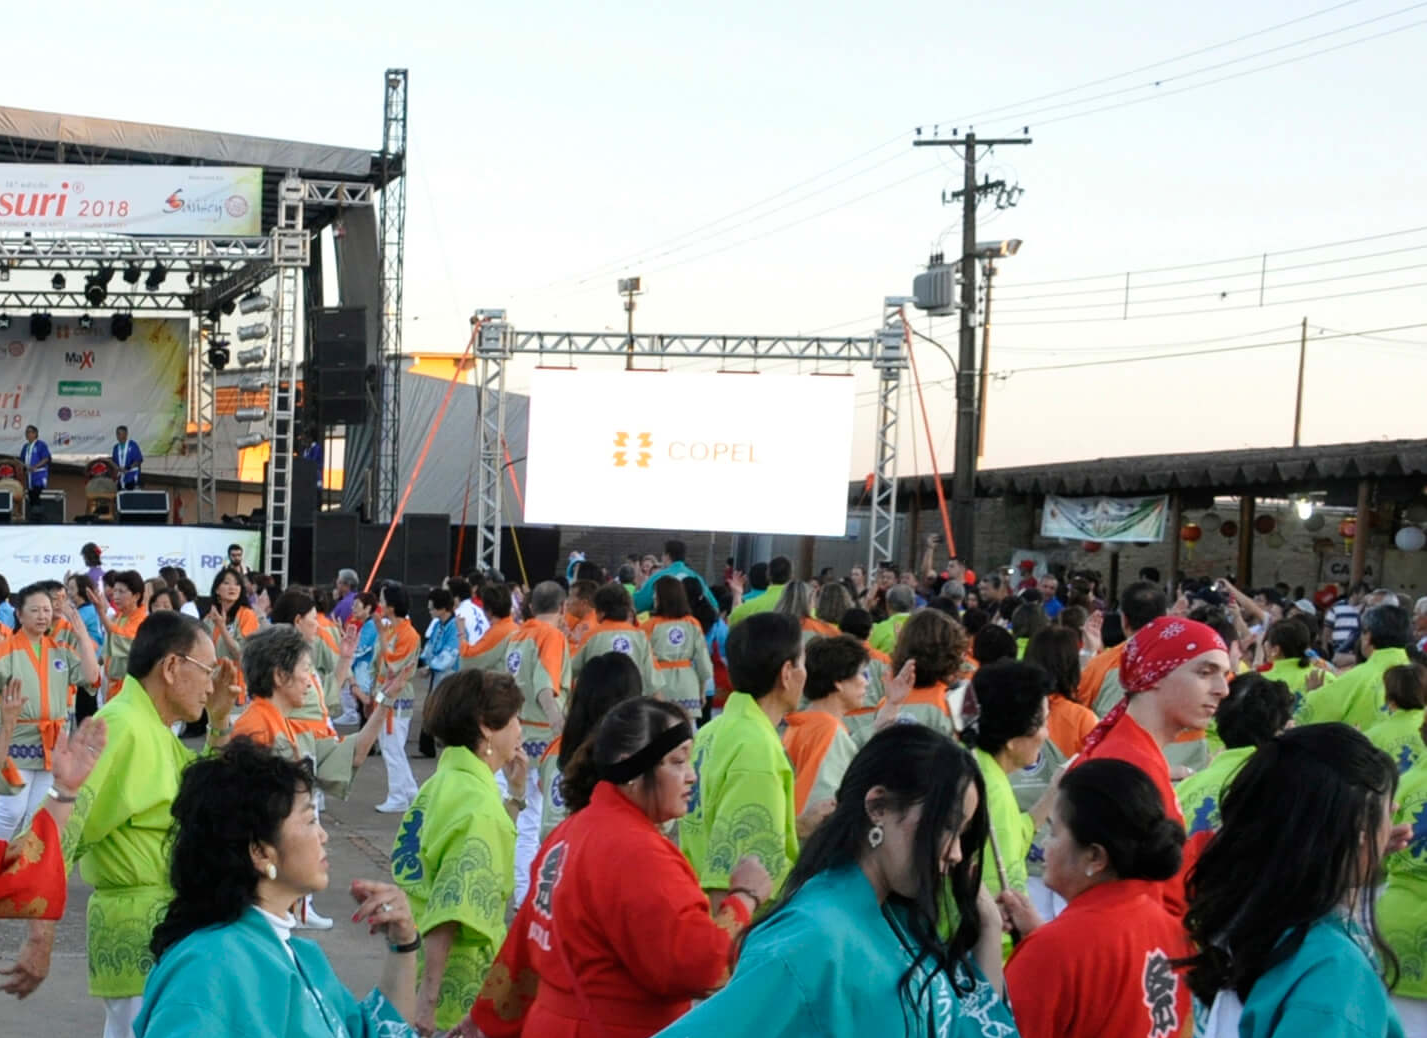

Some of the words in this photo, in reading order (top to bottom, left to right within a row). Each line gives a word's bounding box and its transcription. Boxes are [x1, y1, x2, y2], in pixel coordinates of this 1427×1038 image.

[78, 200, 130, 217] 2018
[668, 440, 759, 463] COPEL
[43, 554, 70, 564] SESI
[201, 555, 224, 568] RP
